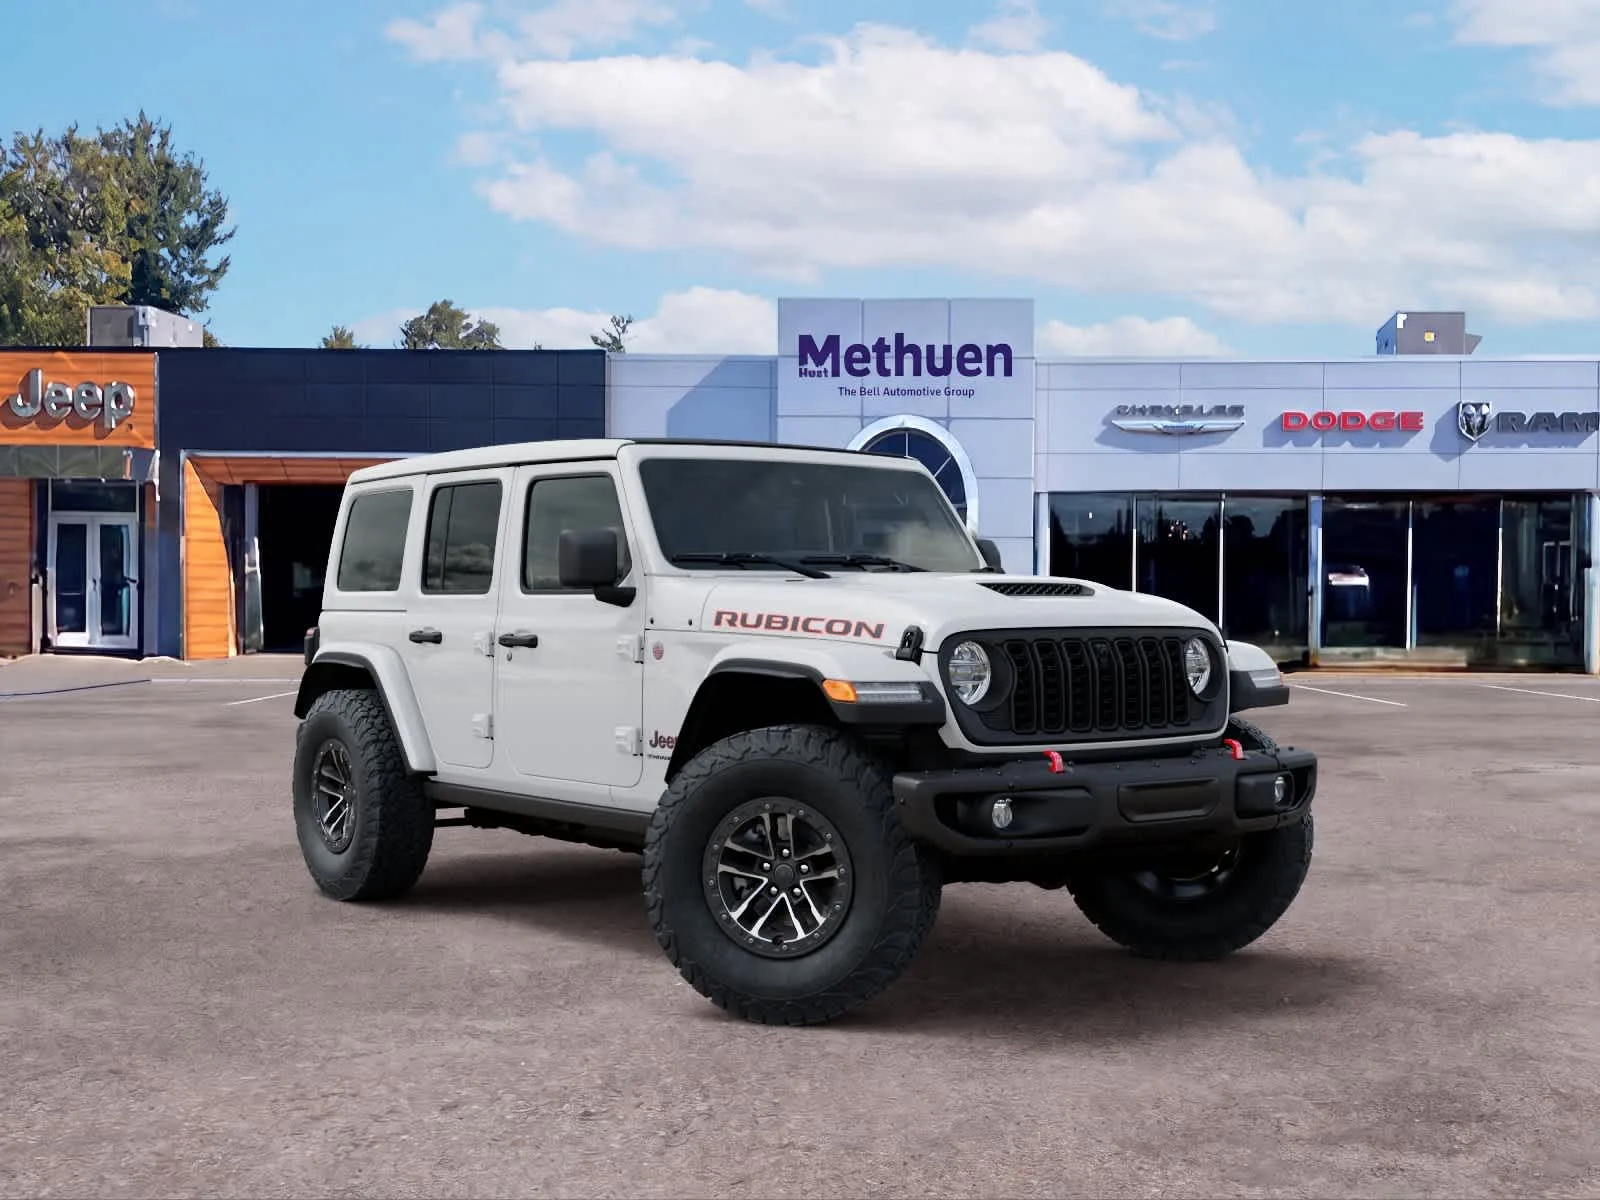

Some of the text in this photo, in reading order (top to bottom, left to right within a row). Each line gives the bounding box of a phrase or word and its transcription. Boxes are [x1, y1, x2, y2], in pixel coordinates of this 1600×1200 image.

[798, 333, 1013, 377] Methuen
[9, 368, 136, 428] Jeep
[838, 387, 975, 399] The Bell Automotive Group
[1282, 411, 1424, 431] DODGE
[1497, 412, 1599, 432] RAM
[714, 610, 885, 639] RUBICON
